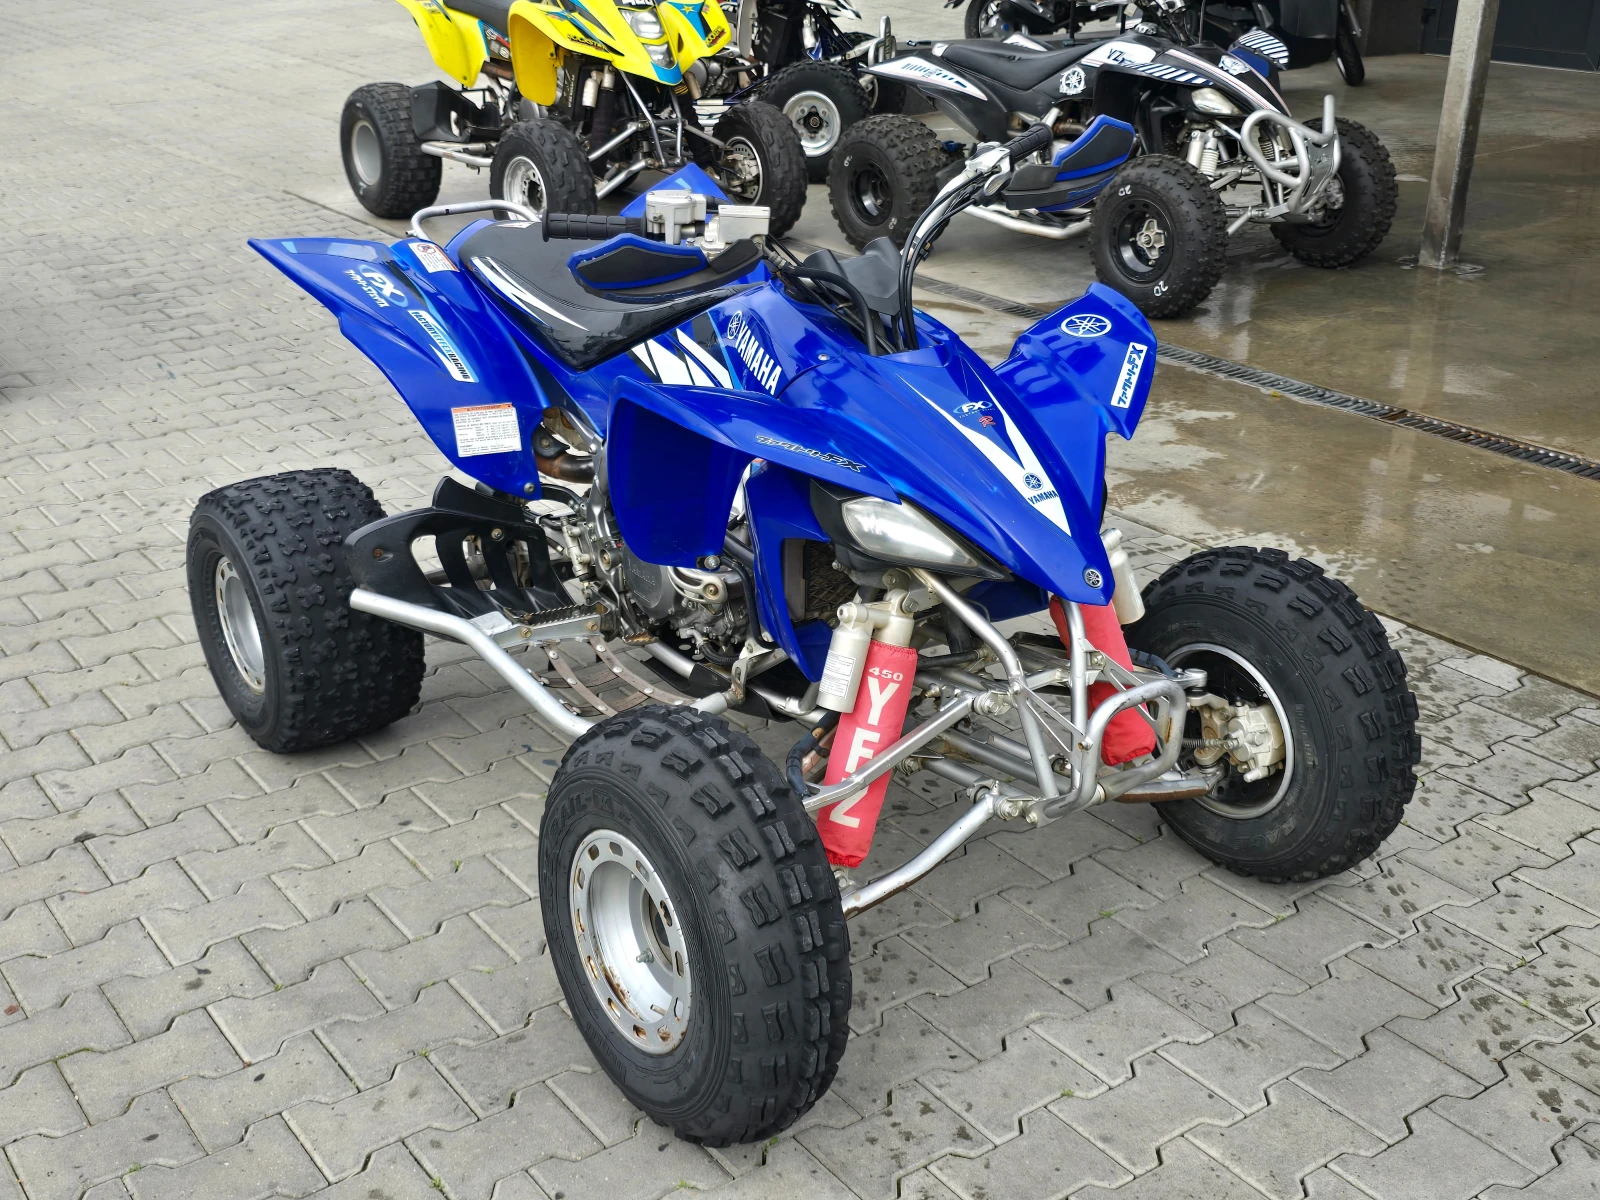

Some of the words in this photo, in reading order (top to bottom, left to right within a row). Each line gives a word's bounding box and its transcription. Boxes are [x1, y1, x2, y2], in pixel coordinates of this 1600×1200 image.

[735, 320, 783, 396] YAMAHA
[1027, 489, 1059, 505] YAMAHA
[868, 666, 904, 682] 450
